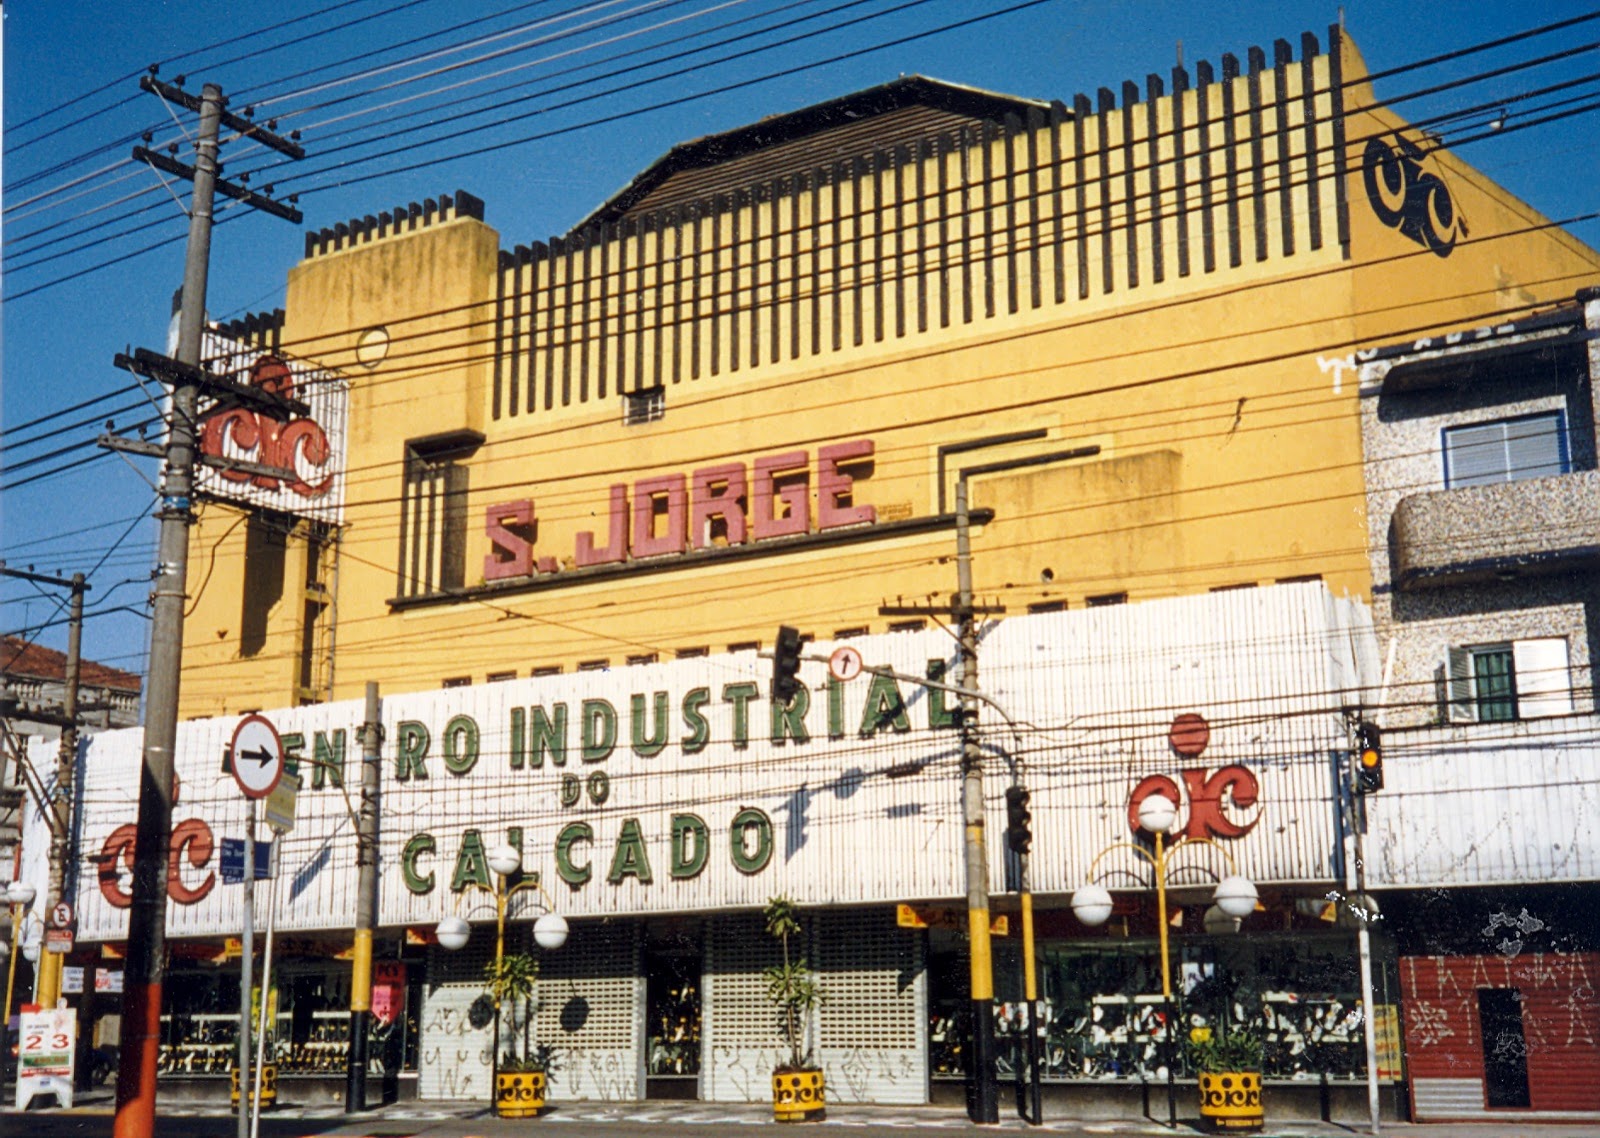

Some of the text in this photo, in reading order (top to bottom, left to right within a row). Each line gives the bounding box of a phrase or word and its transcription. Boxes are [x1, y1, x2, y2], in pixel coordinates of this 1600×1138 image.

[483, 438, 876, 581] S. JORGE
[509, 656, 963, 770] INDUSTRIAL
[561, 769, 610, 807] DO
[26, 1033, 69, 1050] 2 3
